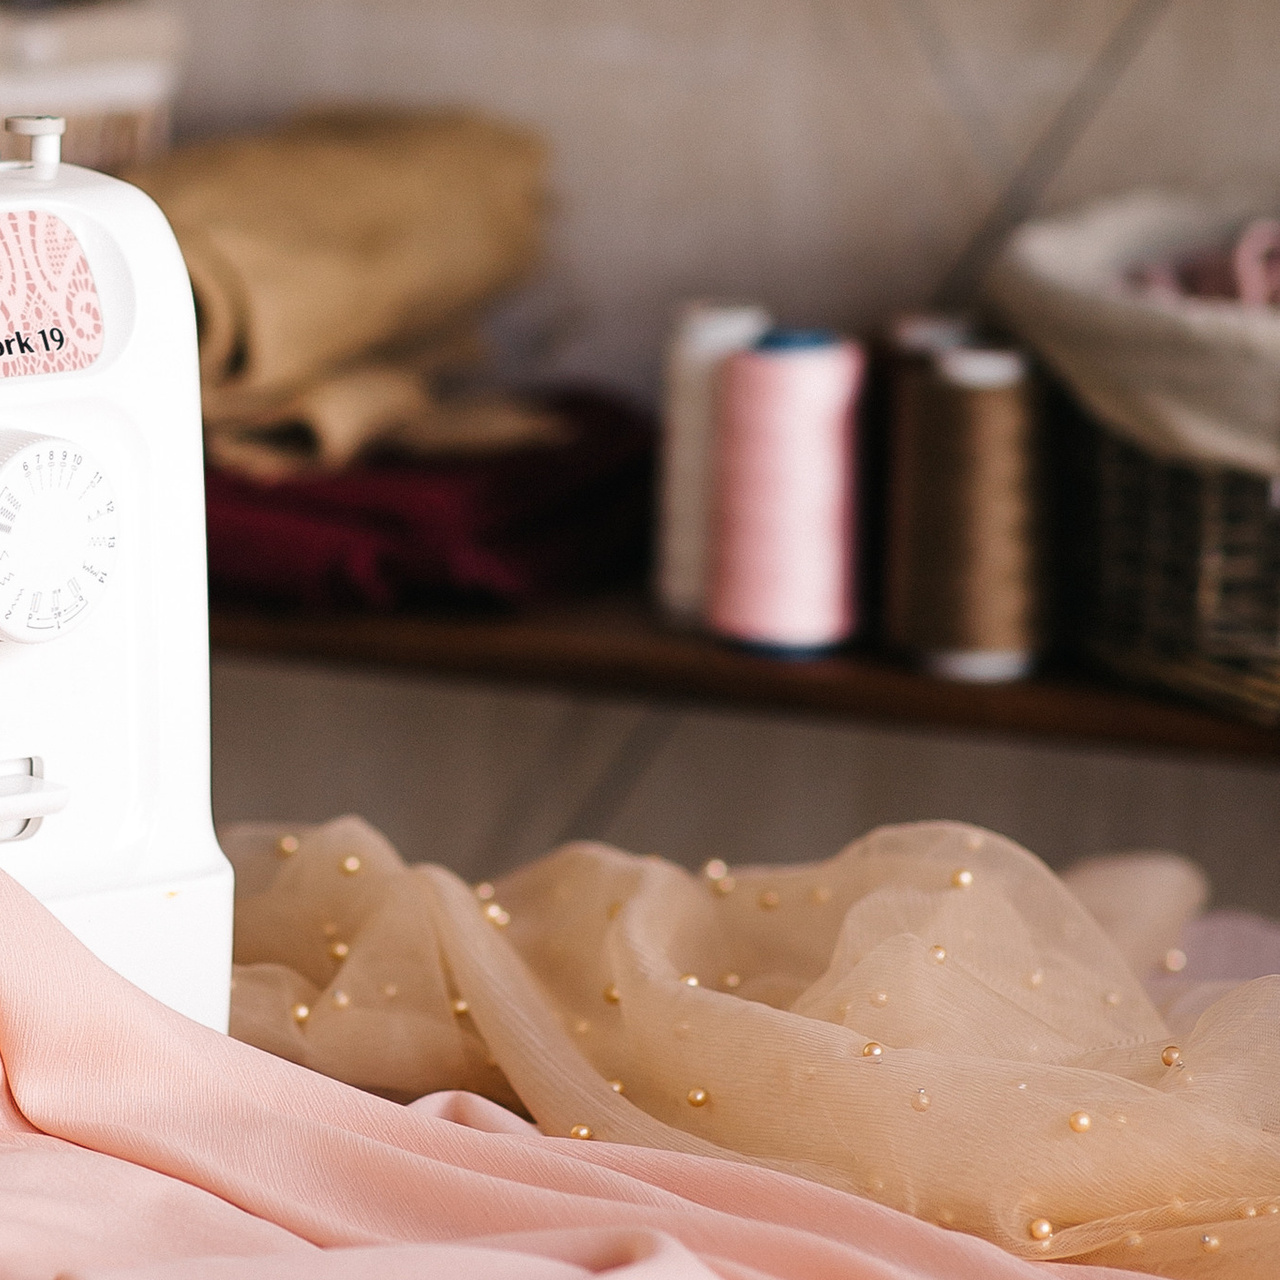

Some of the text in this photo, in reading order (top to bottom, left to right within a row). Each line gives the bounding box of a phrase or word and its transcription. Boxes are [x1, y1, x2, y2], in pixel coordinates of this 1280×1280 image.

[38, 327, 64, 352] 19
[35, 454, 41, 464] 7
[48, 450, 55, 461] 8
[61, 450, 68, 461] 9
[73, 454, 83, 466] 10
[22, 461, 29, 471] 6
[93, 471, 103, 484] 11
[105, 500, 115, 513] 12
[108, 536, 116, 548] 13
[4, 609, 13, 620] 2
